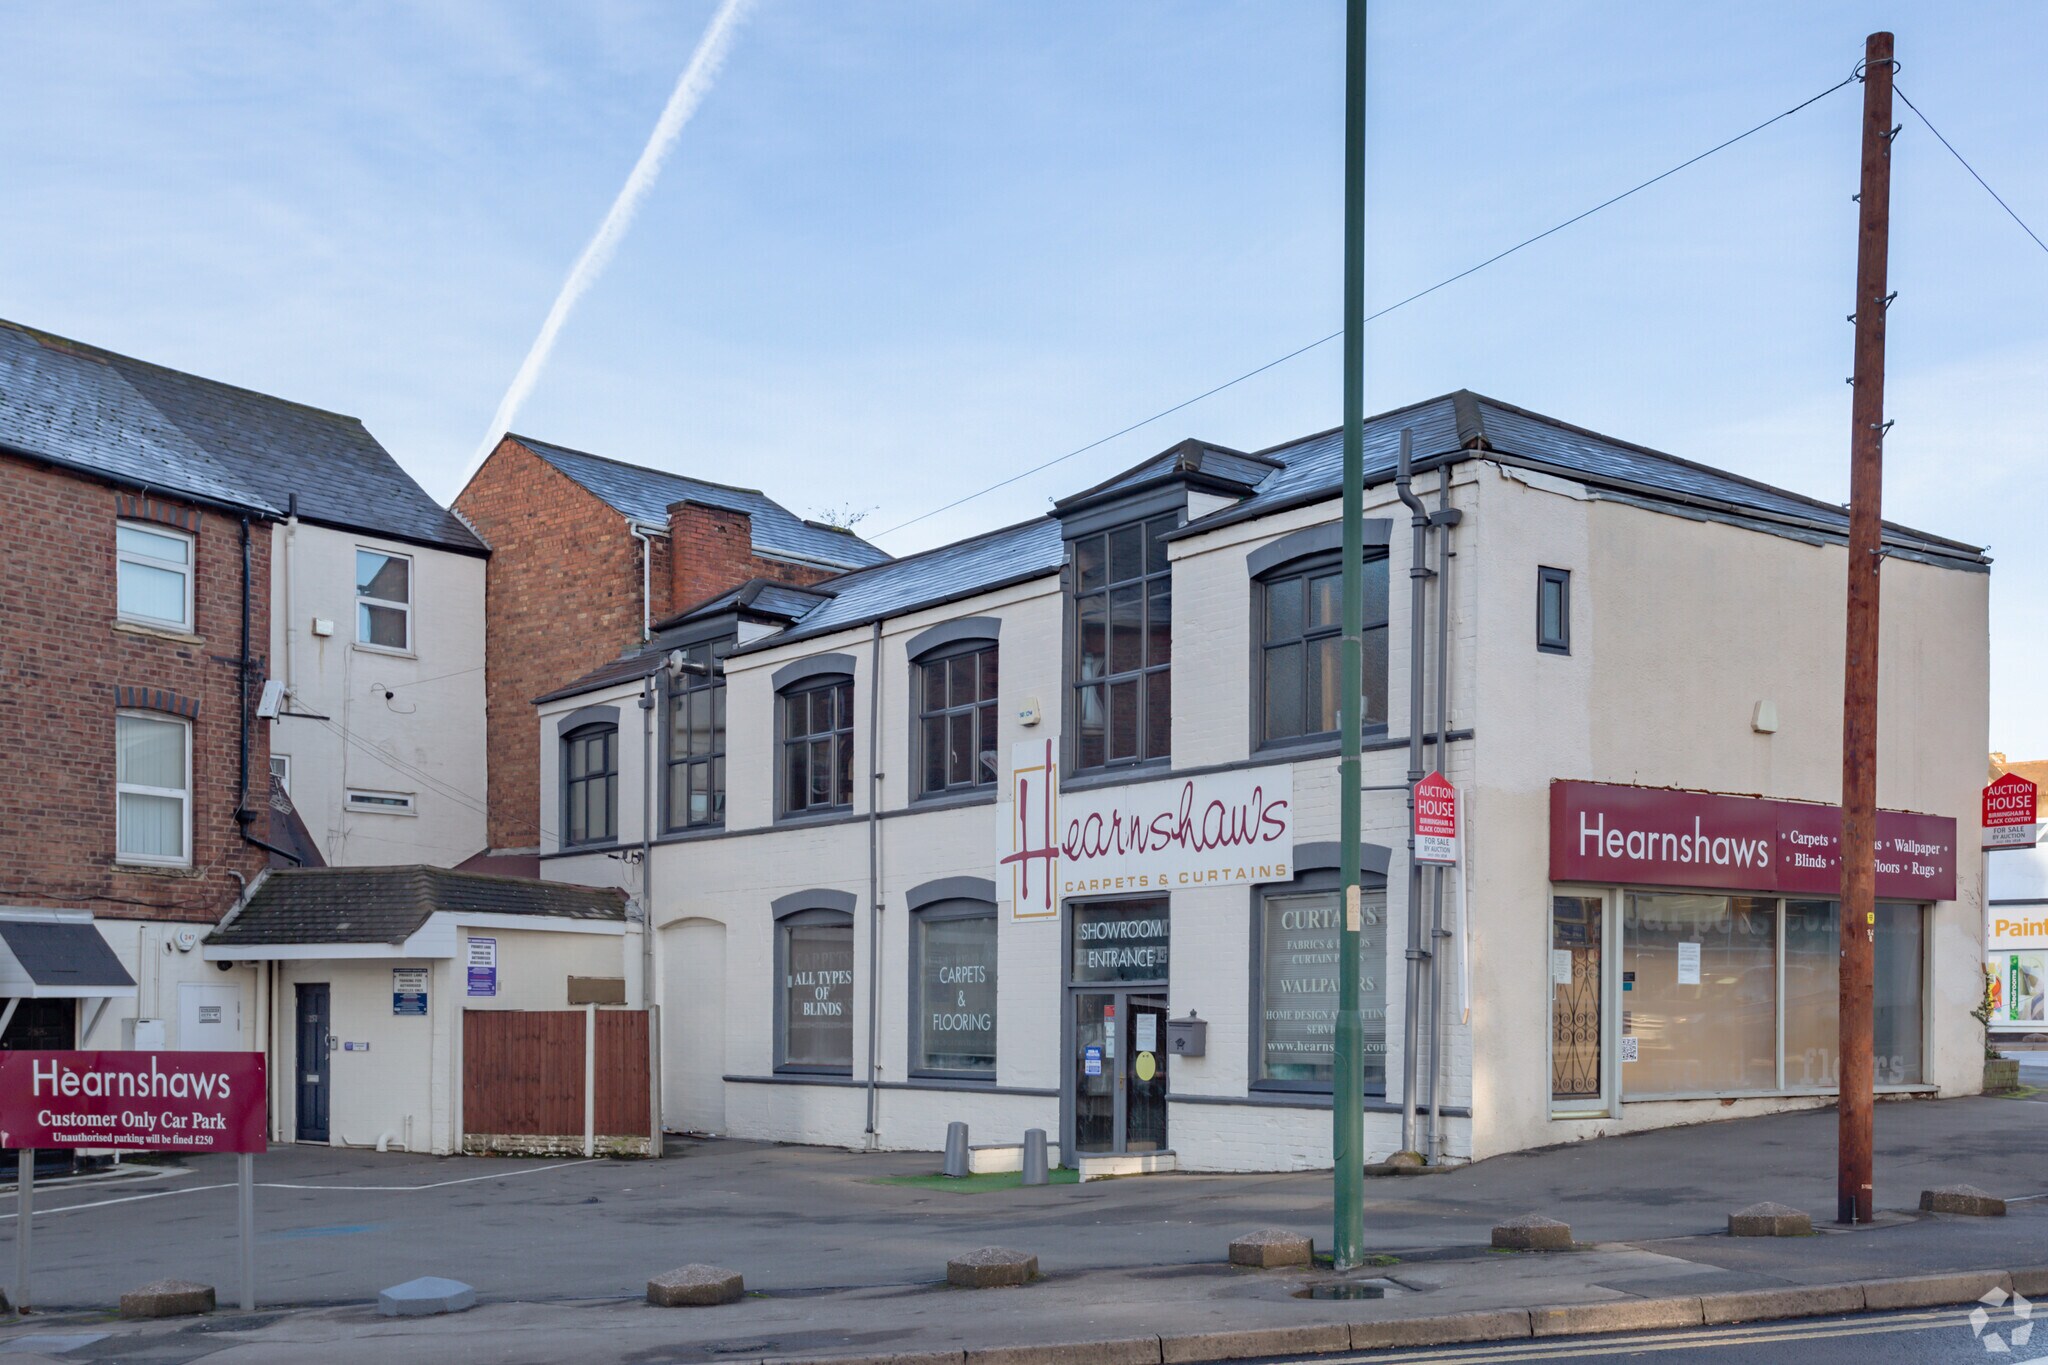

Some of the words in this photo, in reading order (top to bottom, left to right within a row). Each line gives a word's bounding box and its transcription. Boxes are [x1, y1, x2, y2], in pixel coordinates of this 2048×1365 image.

[1419, 785, 1454, 799] AUCTION
[1988, 783, 2033, 796] AUCTION
[1418, 799, 1454, 817] HOUSE
[1987, 795, 2032, 810] HOUSE
[1420, 817, 1449, 826] BIRMINGHAM
[1988, 810, 2024, 818] BIRMINGHAM
[1434, 826, 1454, 834] COUNTRY
[1437, 838, 1449, 846] SALE
[1579, 811, 1768, 869] Hearnshaws
[1790, 830, 1828, 848] Carpets
[1894, 839, 1940, 856] Wallpaper
[1795, 853, 1826, 868] Blinds
[1912, 862, 1935, 878] Rugs
[1065, 875, 1149, 892] CARPETS
[1158, 874, 1169, 885] &
[1178, 864, 1287, 884] CURTAINS
[1081, 920, 1163, 940] SHOWROOM
[1287, 940, 1324, 950] FABRICS
[1326, 940, 1333, 949] &
[1089, 950, 1153, 968] ENTRANCE
[1292, 954, 1332, 964] CURTAIN
[794, 972, 815, 985] ALL
[818, 971, 851, 985] TYPES
[939, 966, 985, 983] CARPETS
[1281, 977, 1375, 993] WALLPARS
[815, 987, 830, 1000] OF
[958, 991, 966, 1007] &
[803, 1002, 842, 1016] BLINDS
[1266, 1010, 1292, 1020] HOME
[1294, 1010, 1328, 1020] DESIGN
[933, 1013, 991, 1031] FLOORING
[33, 1056, 231, 1100] Hearnshaws
[37, 1110, 117, 1127] Customer
[121, 1111, 157, 1131] Only
[161, 1112, 188, 1129] Car
[192, 1112, 226, 1129] Park
[53, 1132, 112, 1143] Unauthorised
[114, 1135, 144, 1145] parking
[146, 1134, 160, 1144] will
[162, 1135, 171, 1144] be
[173, 1134, 193, 1144] fined
[195, 1135, 213, 1145] £250
